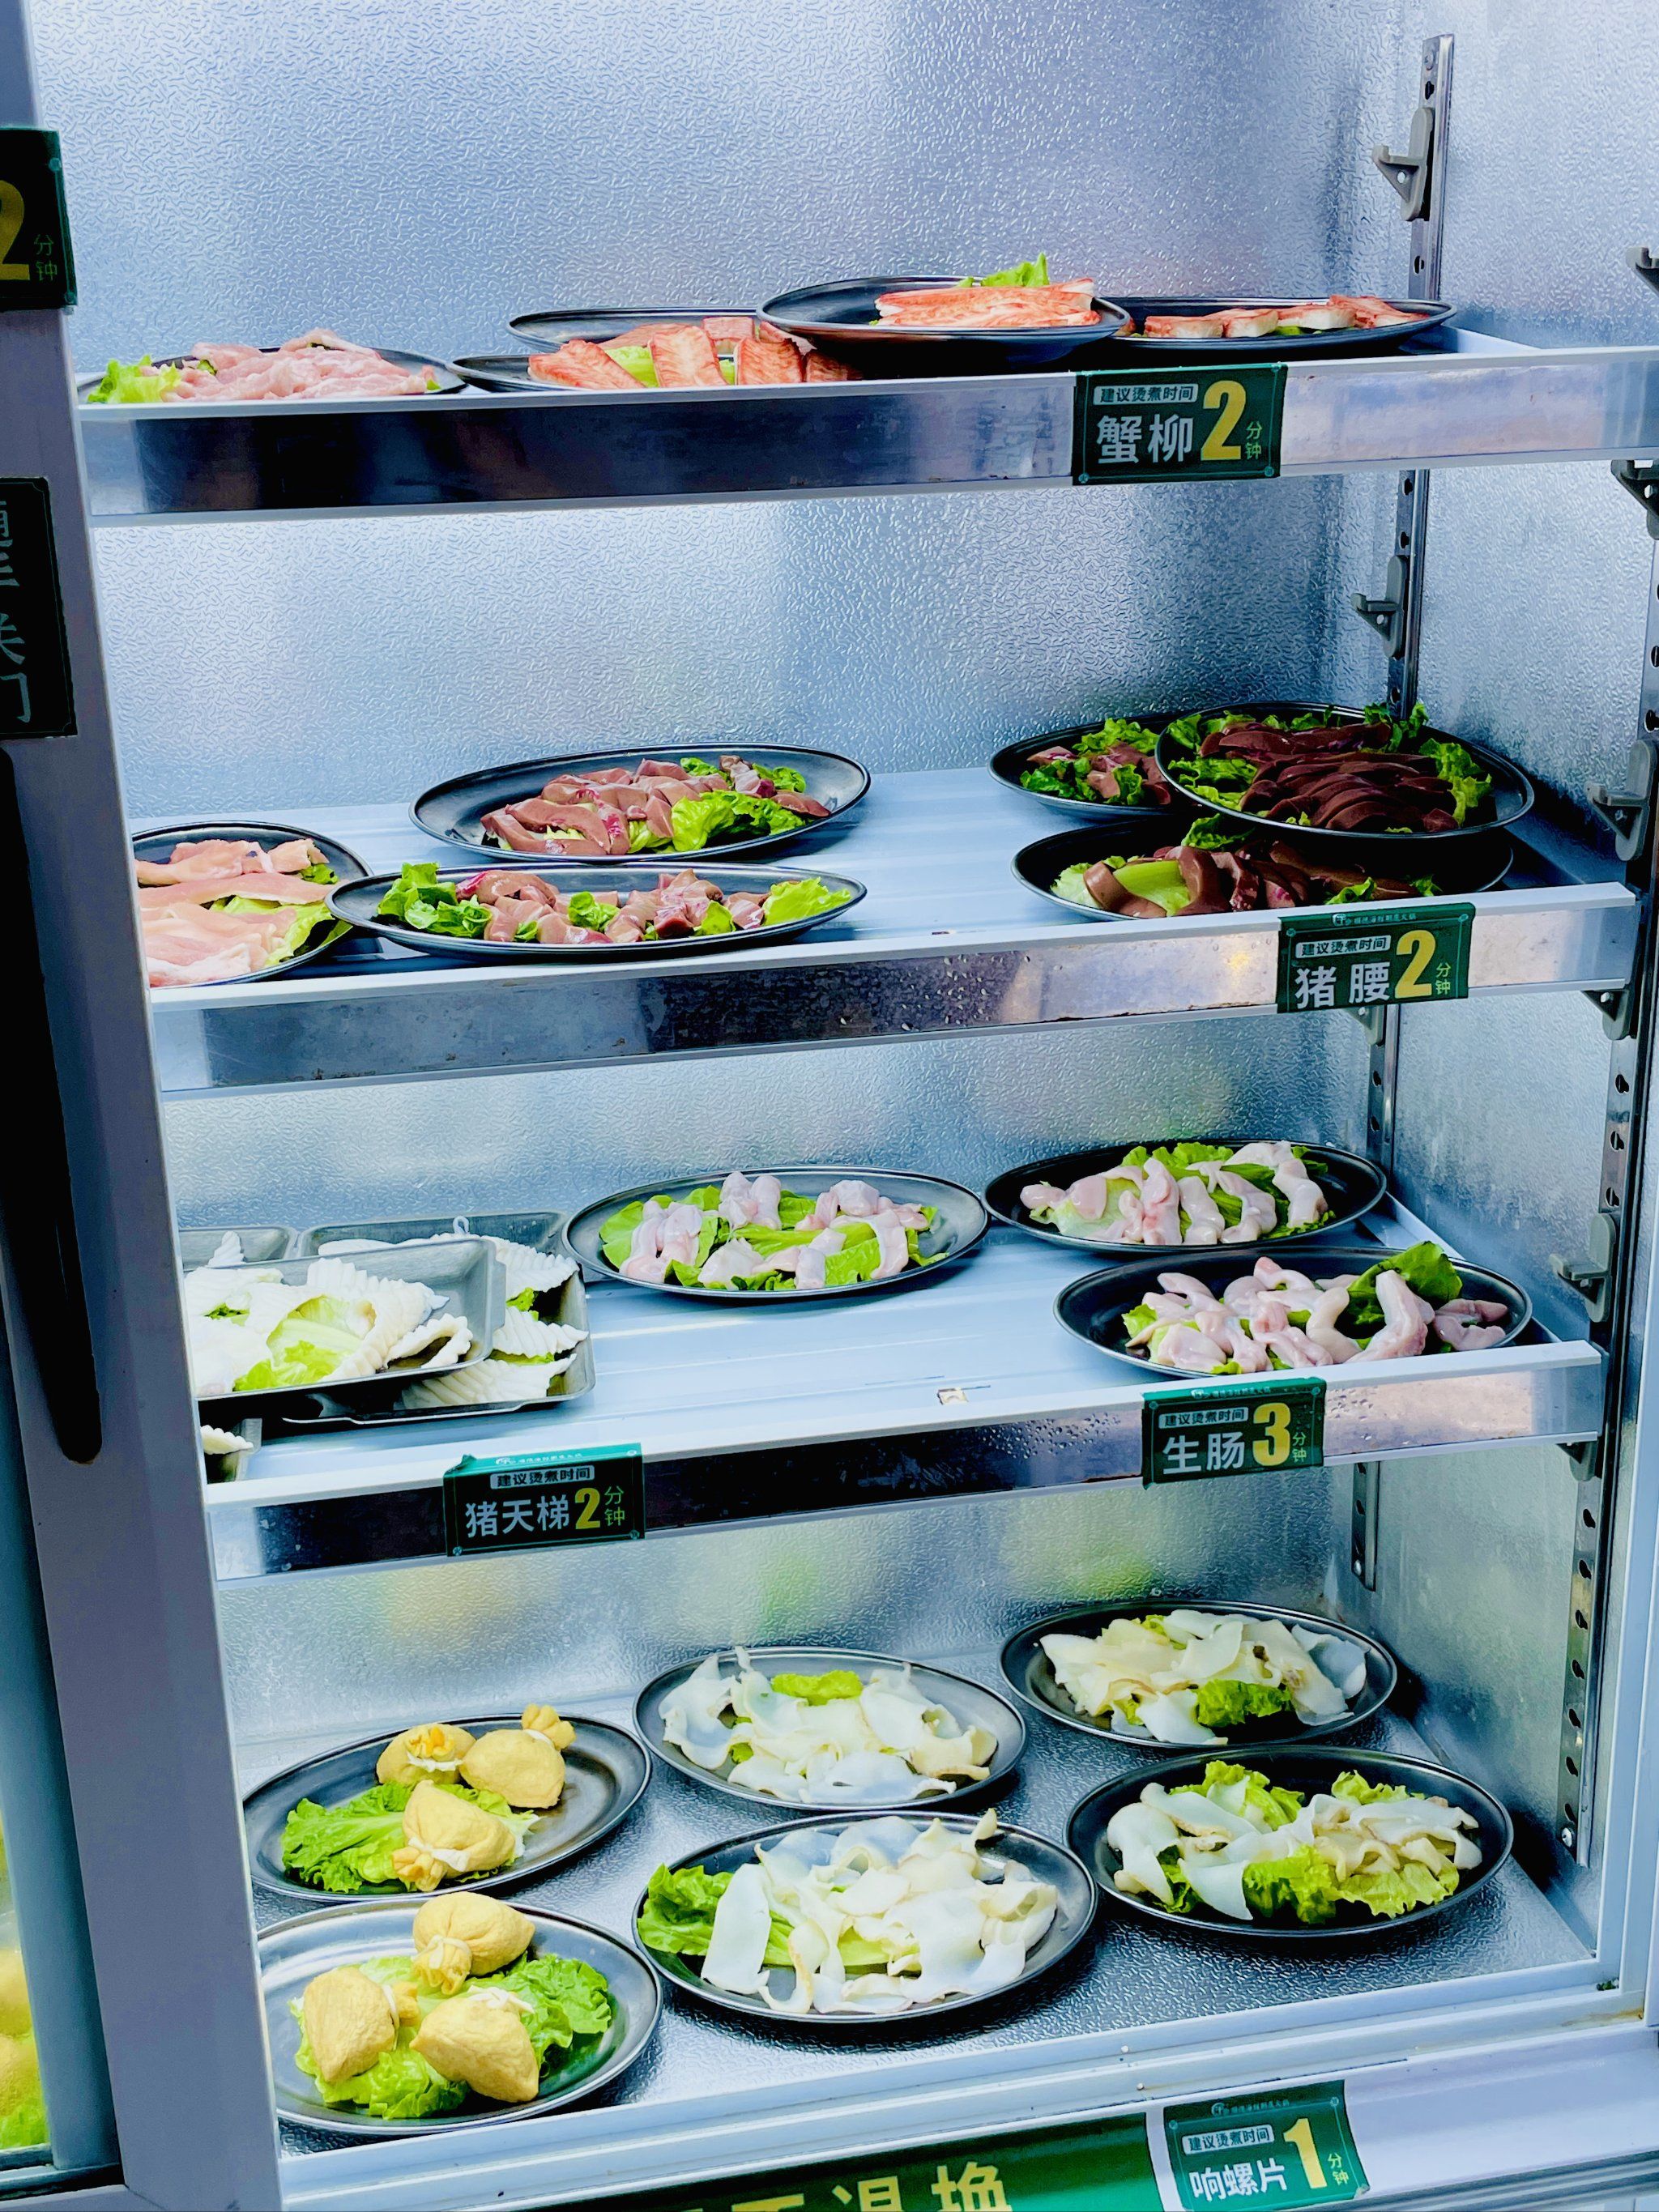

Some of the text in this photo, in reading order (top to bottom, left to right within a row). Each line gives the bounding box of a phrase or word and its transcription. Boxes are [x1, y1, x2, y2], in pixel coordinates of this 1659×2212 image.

[33, 234, 58, 281] 分钟
[1099, 386, 1194, 403] 建议烫煮时间
[1097, 380, 1262, 464] 蟹柳 2 分钟
[1295, 930, 1452, 1009] 猪腰 2 分钟
[1302, 937, 1387, 957] 建议烫煮时间
[1162, 1402, 1307, 1475] 生肠 3 分钟
[1164, 1409, 1245, 1427] 建议烫煮时间
[497, 1467, 591, 1488] 建议烫煮时间
[465, 1485, 625, 1538] 猪天梯 2 分钟
[1188, 2127, 1270, 2152] 建议烫煮时间
[1188, 2118, 1350, 2201] 响螺片 1 分钟
